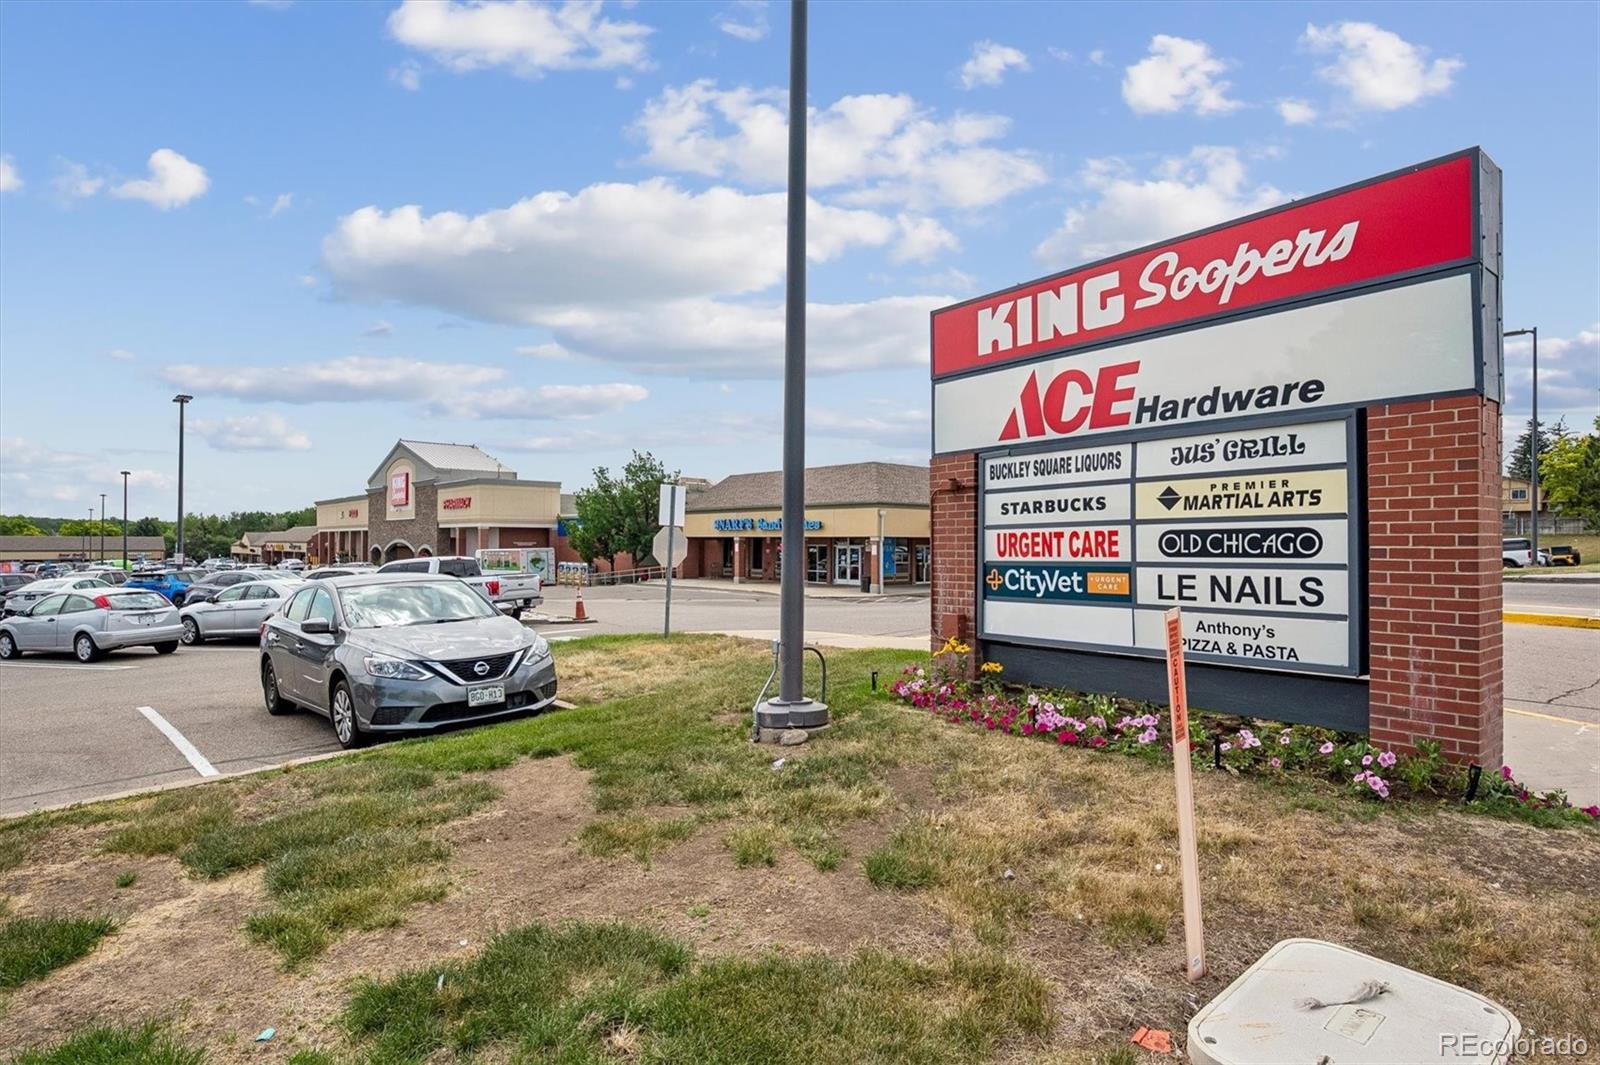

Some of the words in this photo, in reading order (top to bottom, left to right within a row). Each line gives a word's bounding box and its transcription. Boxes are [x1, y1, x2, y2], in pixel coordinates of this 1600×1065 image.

[977, 270, 1125, 357] KING
[1133, 220, 1360, 310] Soopers
[998, 360, 1141, 441] ACE
[1135, 379, 1325, 424] Hardware
[1223, 434, 1306, 462] GRILL
[990, 461, 1031, 480] BUCKLEY
[1033, 456, 1072, 476] SQUARE
[1075, 451, 1121, 473] LIQUORS
[1210, 479, 1289, 491] PREMIER
[1000, 496, 1107, 515] STARBUCKS
[1183, 492, 1264, 511] MARTIAL
[1267, 489, 1322, 508] ARTS
[996, 531, 1064, 558] URGENT
[1068, 530, 1119, 558] CARE
[1162, 533, 1201, 554] OLD
[1206, 532, 1319, 555] CHICAGO
[1004, 568, 1083, 598] CityVet
[1157, 574, 1197, 601] LE
[1209, 575, 1325, 607] NAILS
[1195, 620, 1276, 641] Anthony's
[1226, 642, 1238, 655] &
[1243, 643, 1300, 662] PASTA
[1173, 658, 1182, 721] CAUTION
